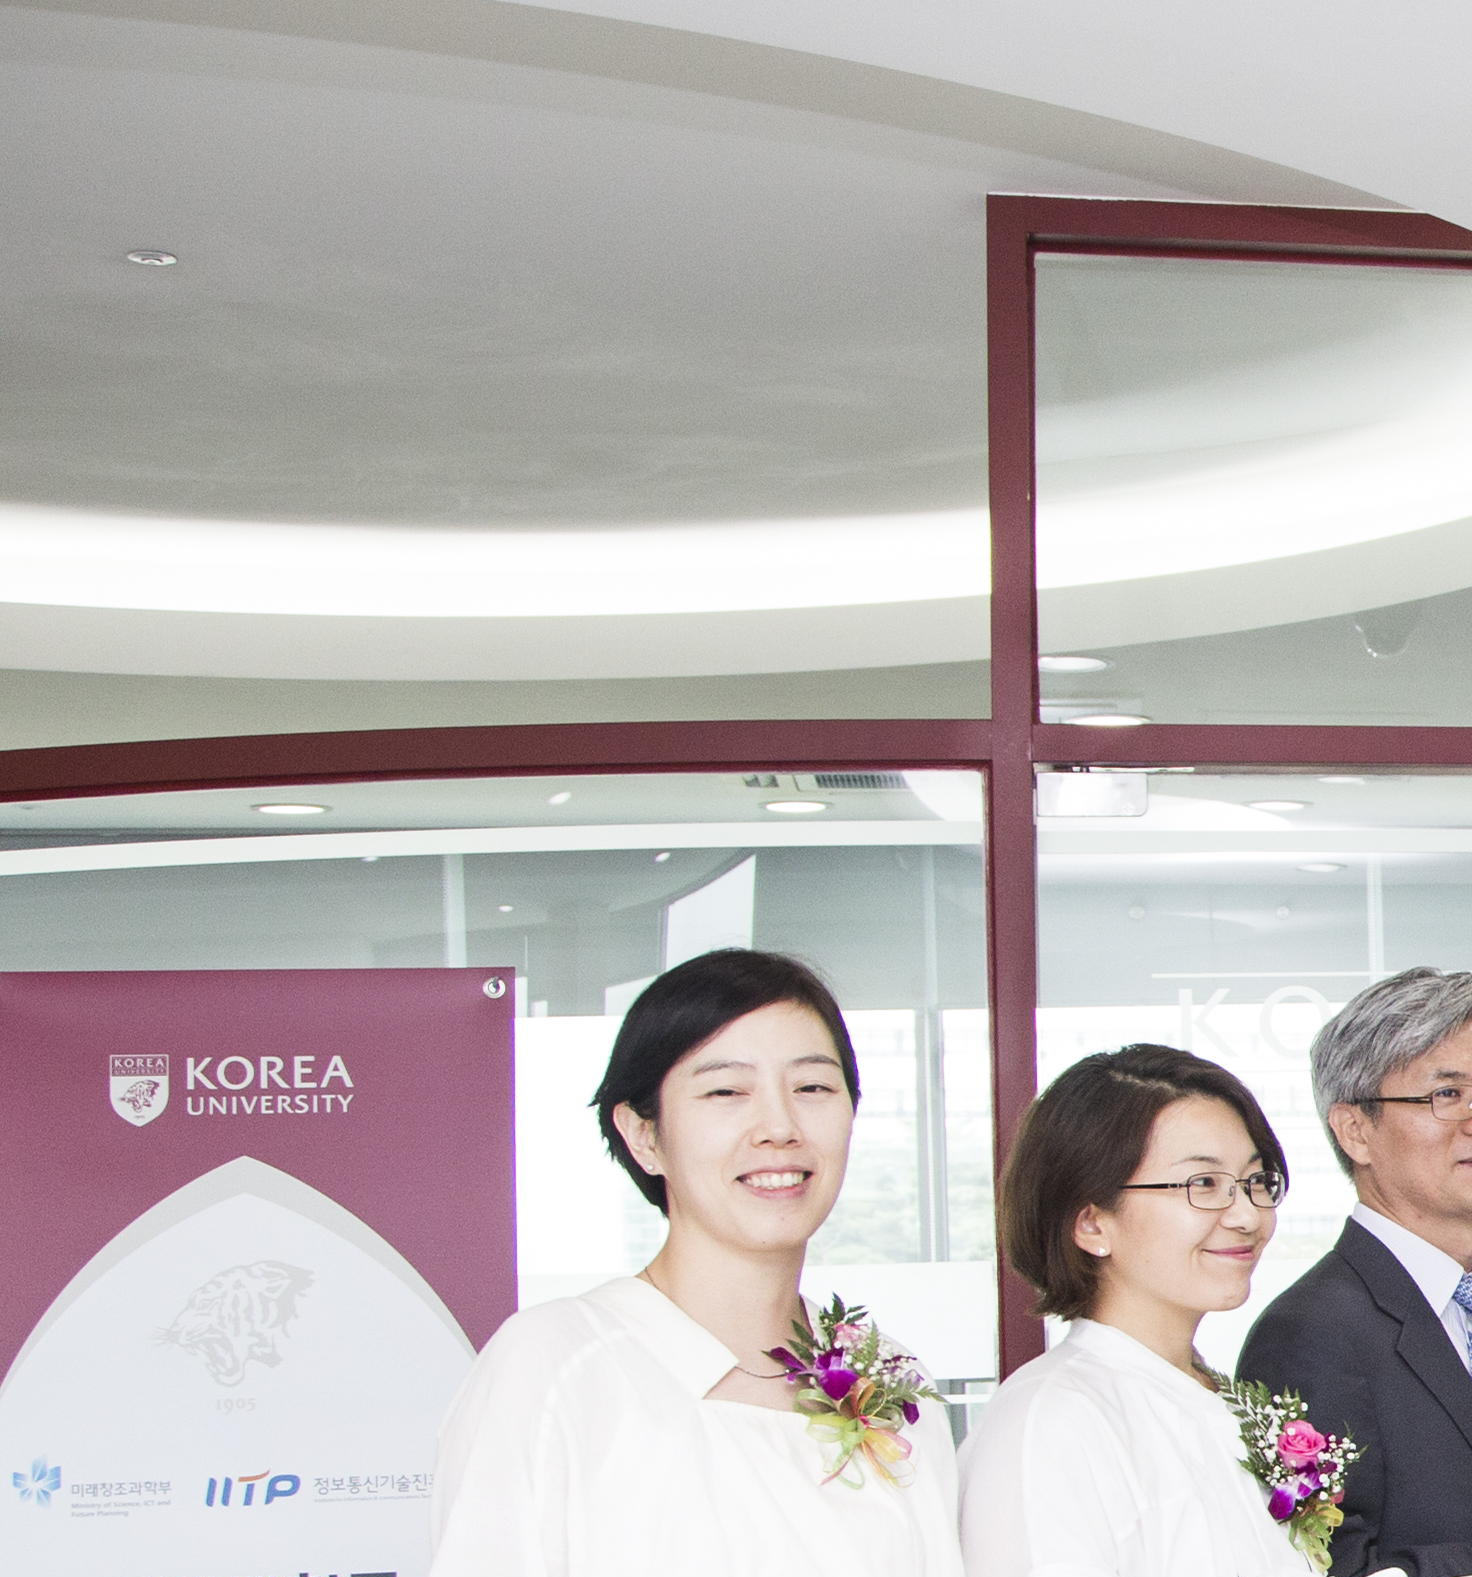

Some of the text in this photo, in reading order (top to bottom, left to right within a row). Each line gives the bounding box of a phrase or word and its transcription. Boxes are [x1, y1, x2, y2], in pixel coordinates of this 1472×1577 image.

[114, 1058, 164, 1068] KOREA
[187, 1055, 354, 1090] KOREA
[187, 1095, 353, 1115] UNIVERSITY
[216, 1398, 256, 1415] 1905
[72, 1481, 172, 1498] 미래창조과학부
[205, 1468, 301, 1507] IITP
